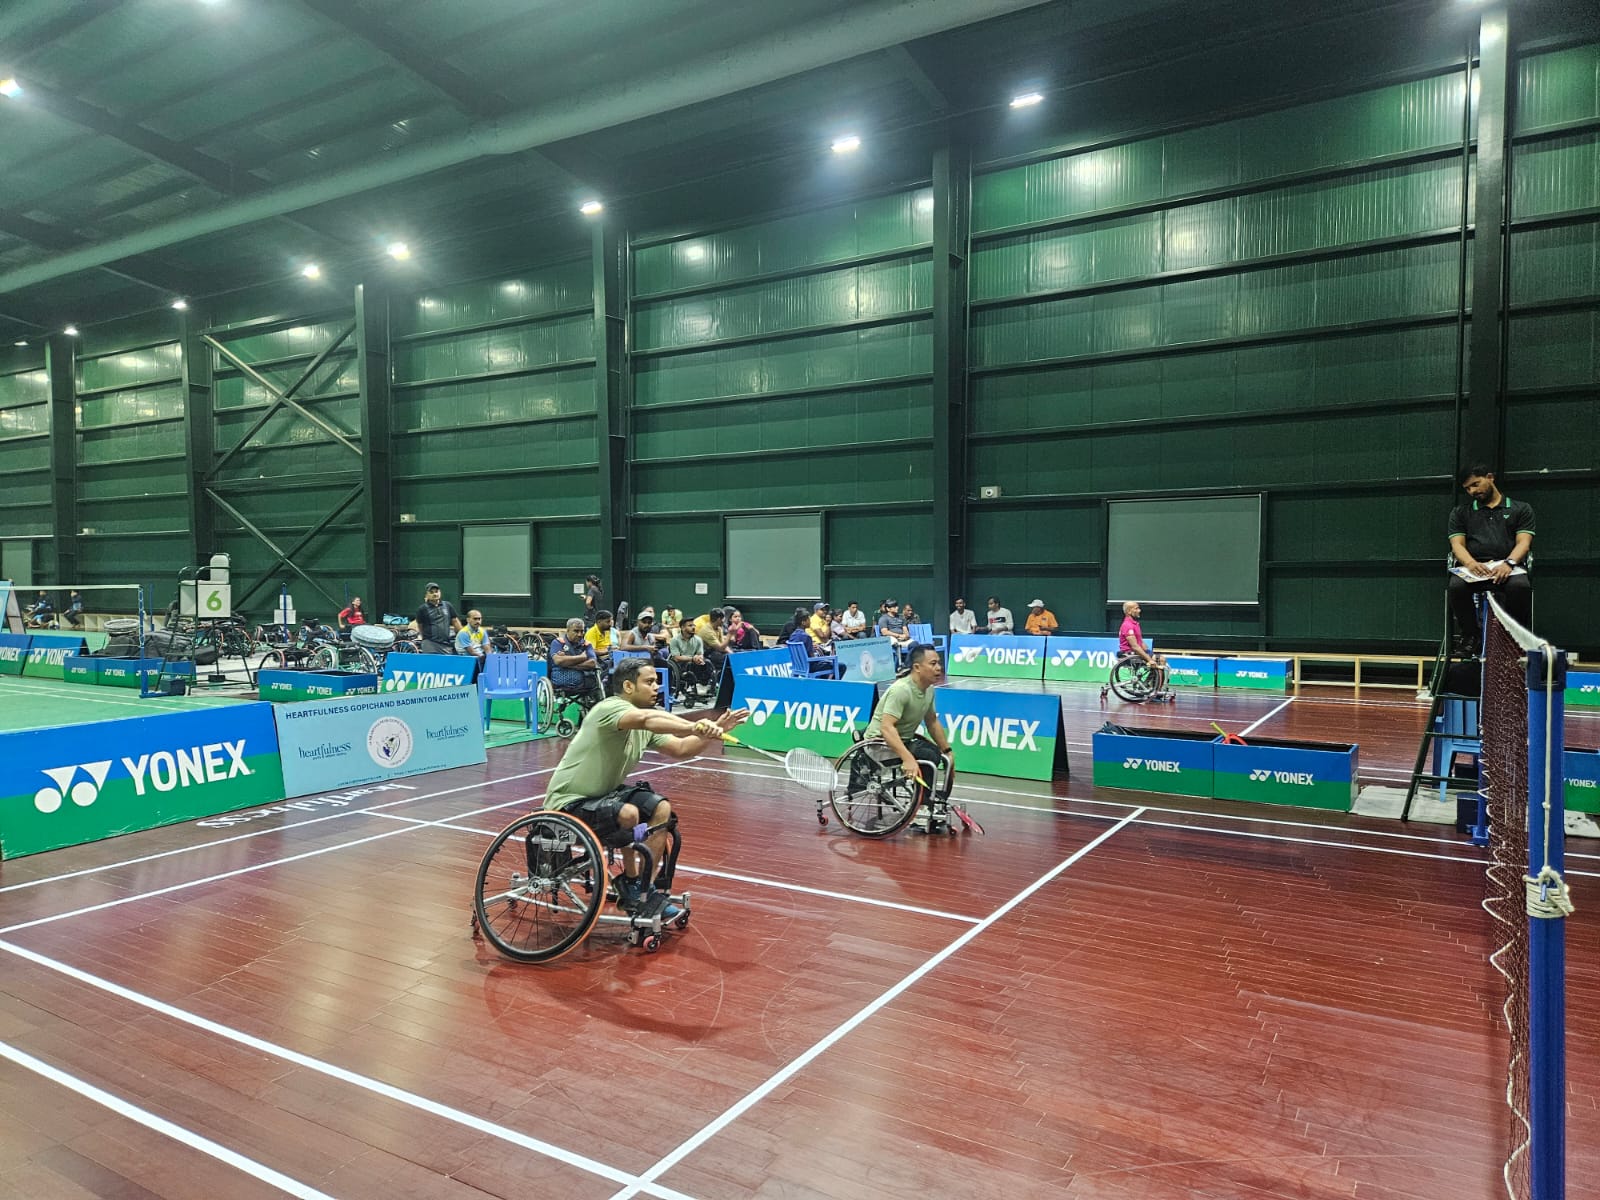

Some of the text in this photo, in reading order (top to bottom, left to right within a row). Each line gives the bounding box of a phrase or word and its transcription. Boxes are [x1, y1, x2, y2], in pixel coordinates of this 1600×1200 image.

[206, 590, 222, 612] 6
[985, 647, 1037, 666] YONEX
[1248, 671, 1268, 679] YONEX
[286, 691, 470, 720] HEARTFULNESS GOPICHAND BADMINTON ACADEMY
[783, 701, 861, 734] YONEX
[944, 713, 1040, 752] YONEX
[298, 742, 352, 759] heartfulness
[121, 739, 250, 796] YONEX
[1144, 759, 1181, 774] YONEX
[1273, 771, 1314, 786] YONEX
[1568, 778, 1597, 788] YONEX
